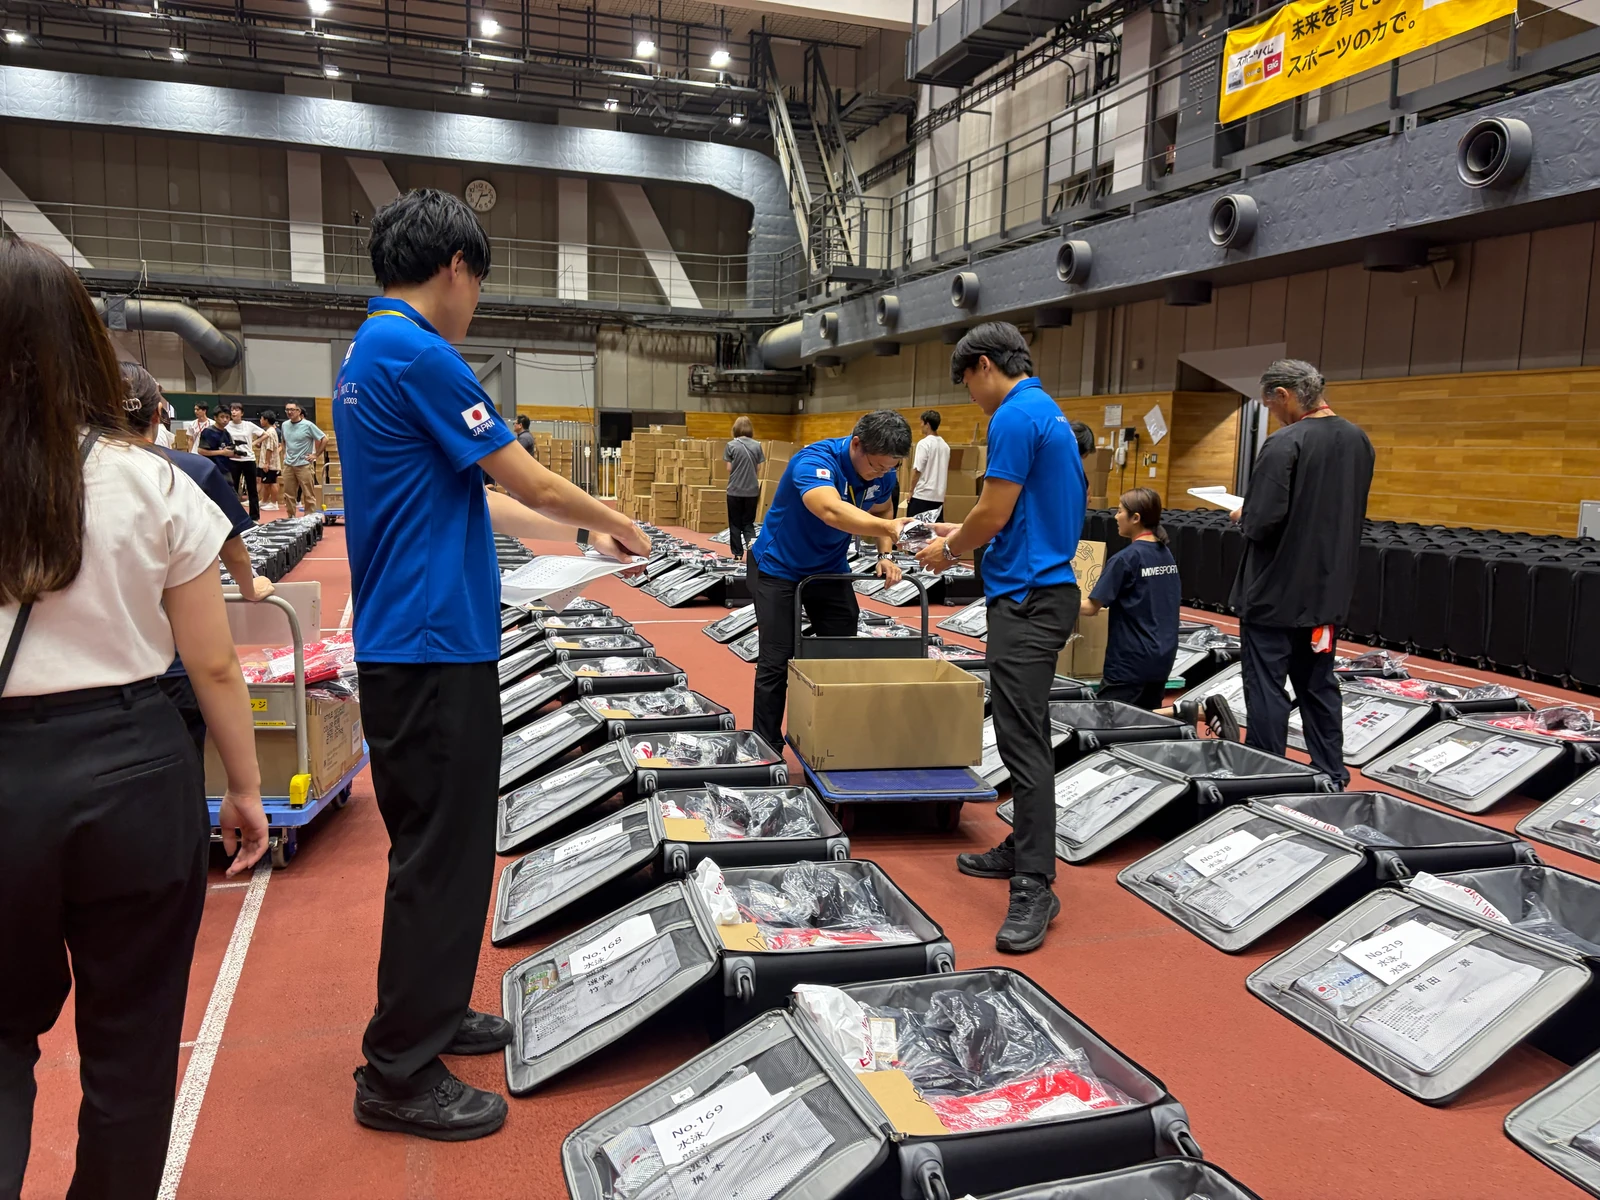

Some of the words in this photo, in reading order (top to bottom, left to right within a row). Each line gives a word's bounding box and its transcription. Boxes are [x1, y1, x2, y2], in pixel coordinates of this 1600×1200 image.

[472, 418, 495, 437] JAPAN
[1199, 845, 1232, 865] No.218
[582, 936, 622, 962] No.168
[1364, 939, 1404, 960] No.219
[1389, 961, 1412, 976] 水球
[1413, 975, 1441, 993] 新田
[671, 1104, 724, 1139] No.169
